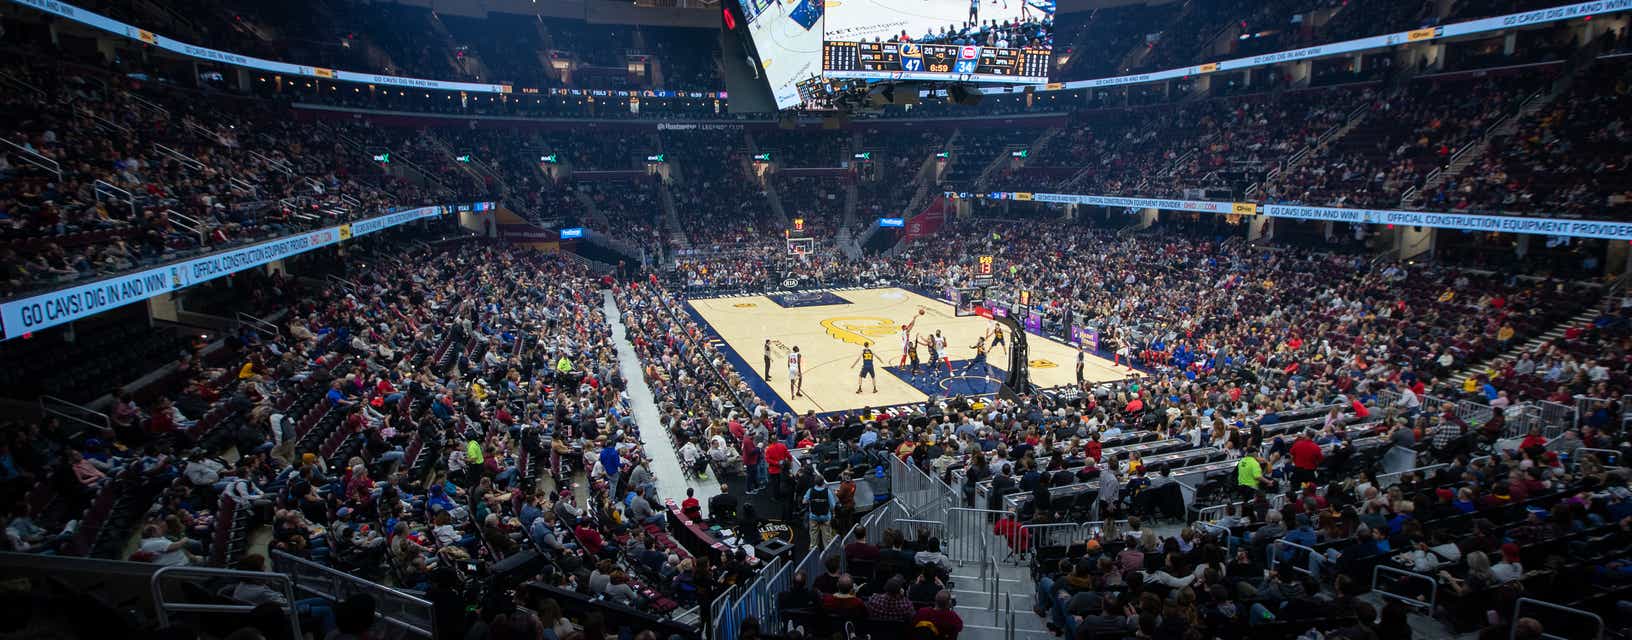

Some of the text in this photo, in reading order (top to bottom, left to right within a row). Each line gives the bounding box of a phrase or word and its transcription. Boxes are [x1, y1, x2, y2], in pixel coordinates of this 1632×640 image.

[1565, 7, 1578, 17] IN
[1579, 3, 1602, 14] AND
[947, 48, 957, 56] 13
[905, 59, 920, 71] 47
[930, 64, 949, 72] 6:59
[958, 61, 972, 72] 34
[1134, 199, 1158, 208] EQUIPMENT
[1270, 207, 1359, 220] GO CAVS! DIG IN AND WIN!
[1387, 213, 1424, 224] OFFICIAL
[1425, 214, 1500, 229] CONSTRUCTION
[1502, 219, 1570, 233] EQUIPMENT
[982, 263, 991, 274] 13
[21, 303, 43, 327] GO
[46, 293, 83, 320] CAVS!
[85, 290, 105, 309] DIG
[107, 286, 120, 303] IN
[122, 282, 143, 301] AND
[144, 272, 167, 294] WIN!
[193, 260, 223, 279] OFFICIAL
[223, 250, 265, 271] CONSTRUCTION
